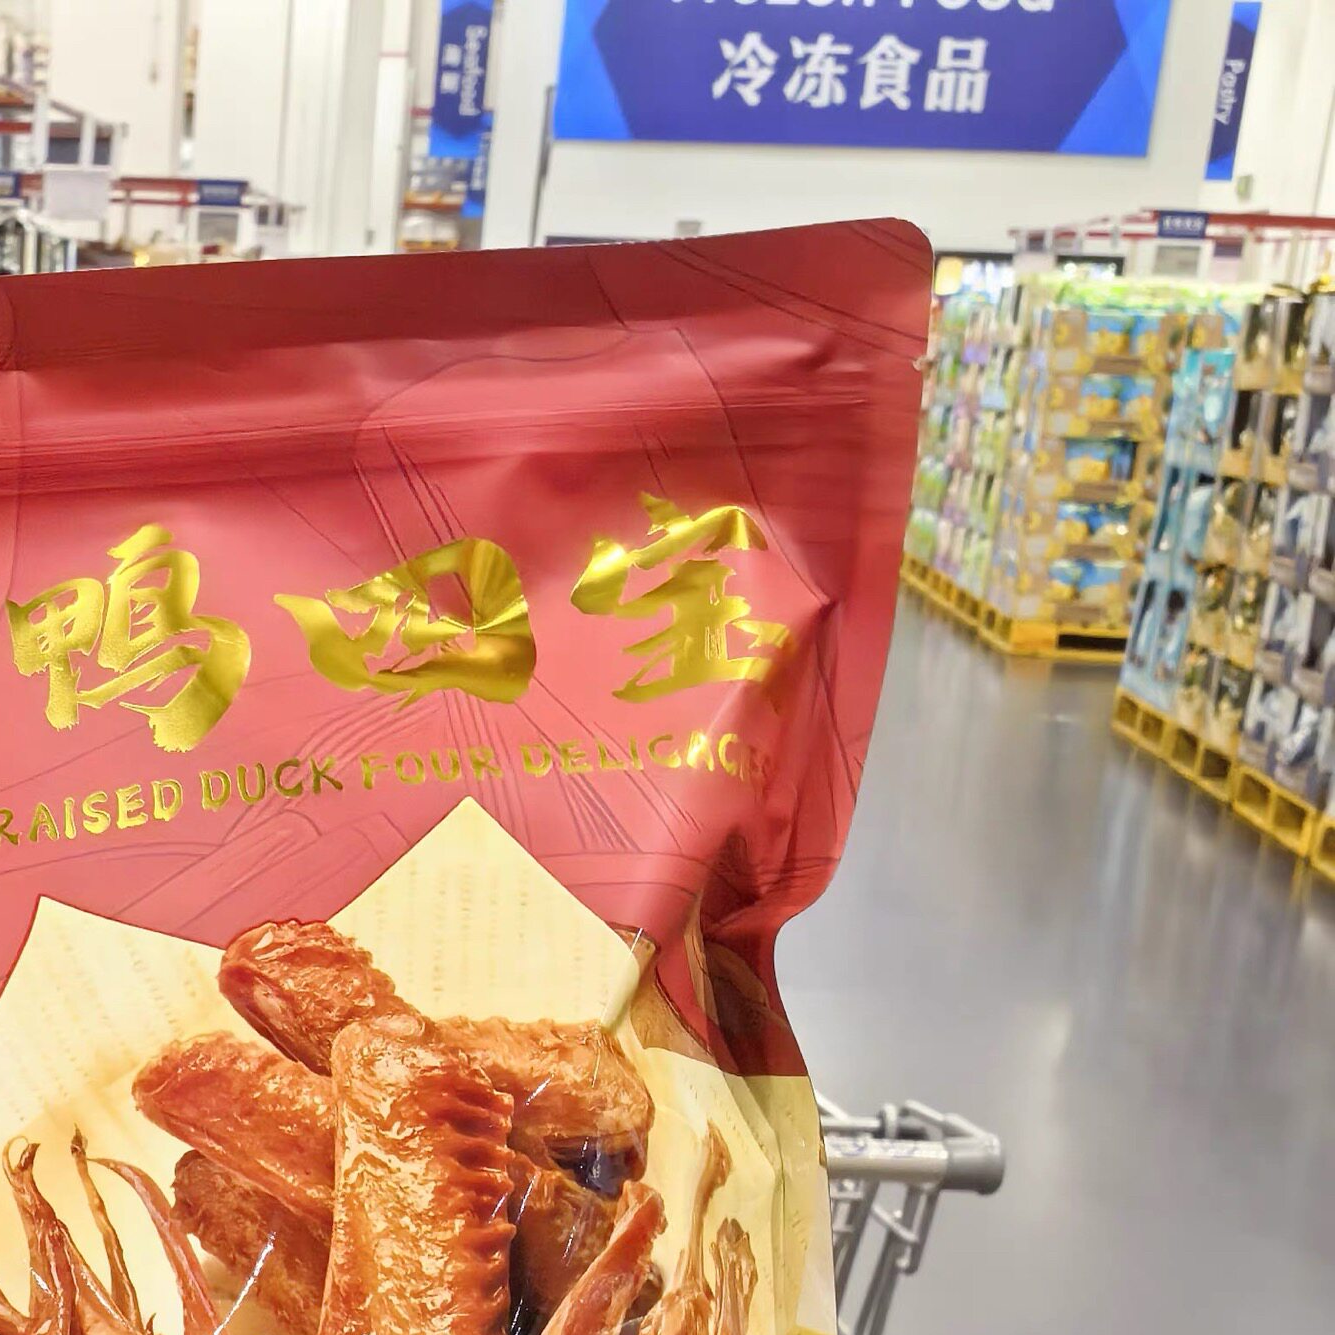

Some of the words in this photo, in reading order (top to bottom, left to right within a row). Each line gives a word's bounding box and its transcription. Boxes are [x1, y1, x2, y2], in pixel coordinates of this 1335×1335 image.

[711, 31, 990, 114] 冷冻食品
[201, 757, 344, 811] DUCK
[361, 746, 504, 791] FOUR
